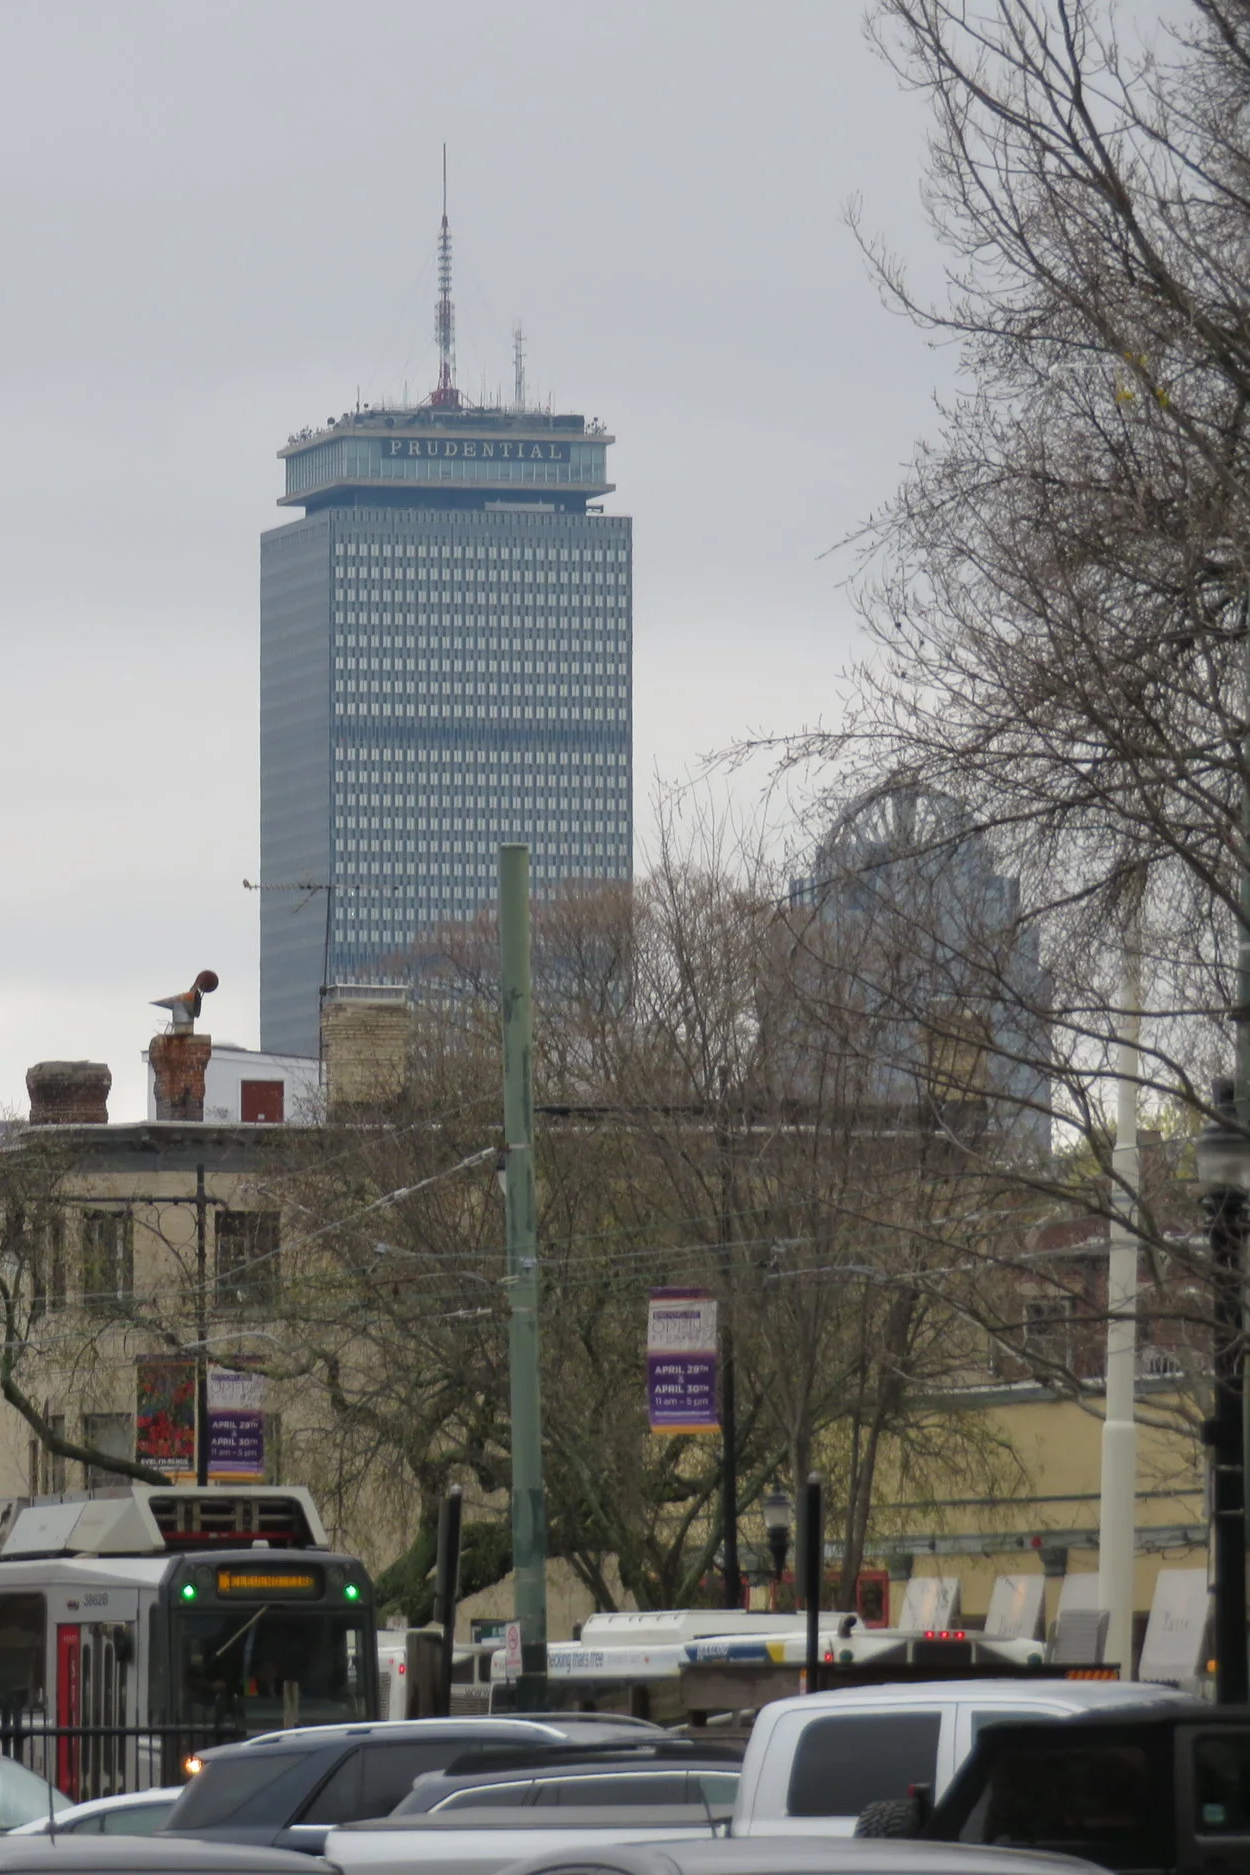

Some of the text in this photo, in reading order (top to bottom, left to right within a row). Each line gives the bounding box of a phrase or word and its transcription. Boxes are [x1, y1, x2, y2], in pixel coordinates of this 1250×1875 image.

[389, 439, 562, 459] PRUDENTIAL
[652, 1320, 701, 1333] OPEN
[654, 1365, 684, 1375] APRIL
[654, 1384, 710, 1394] APRIL 30TH
[663, 1398, 678, 1406] am
[694, 1398, 709, 1407] pm
[212, 1420, 237, 1429] APRIL
[211, 1437, 259, 1446] APRIL 30TH
[218, 1449, 231, 1457] am
[244, 1449, 257, 1459] pm
